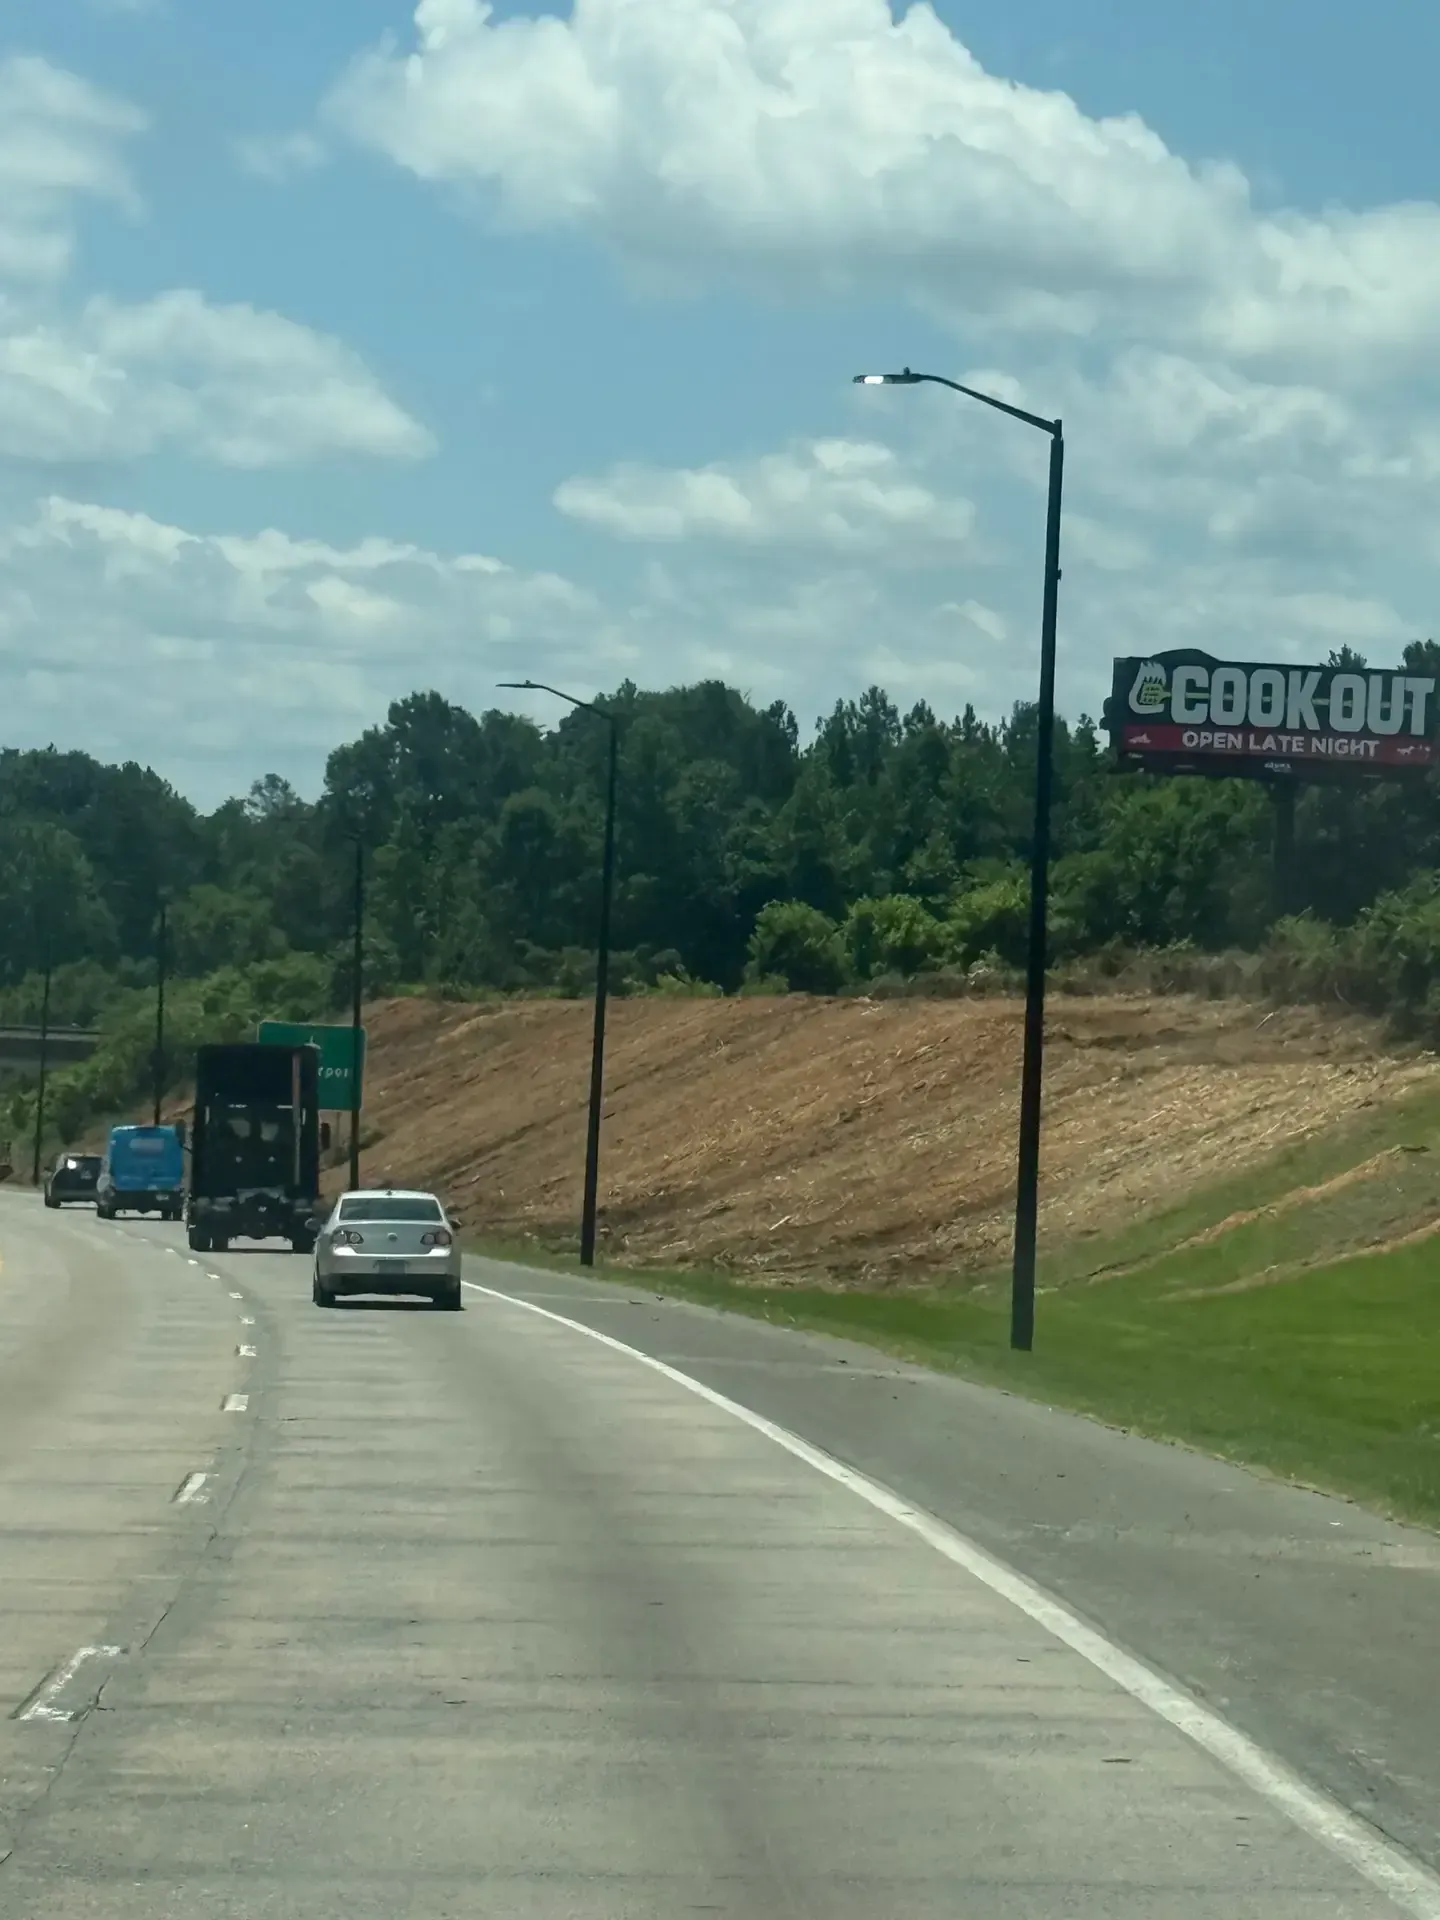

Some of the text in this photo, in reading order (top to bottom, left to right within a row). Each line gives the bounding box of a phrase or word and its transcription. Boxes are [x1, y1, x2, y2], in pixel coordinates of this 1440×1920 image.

[1182, 730, 1380, 758] OPEN LATE NIGHT
